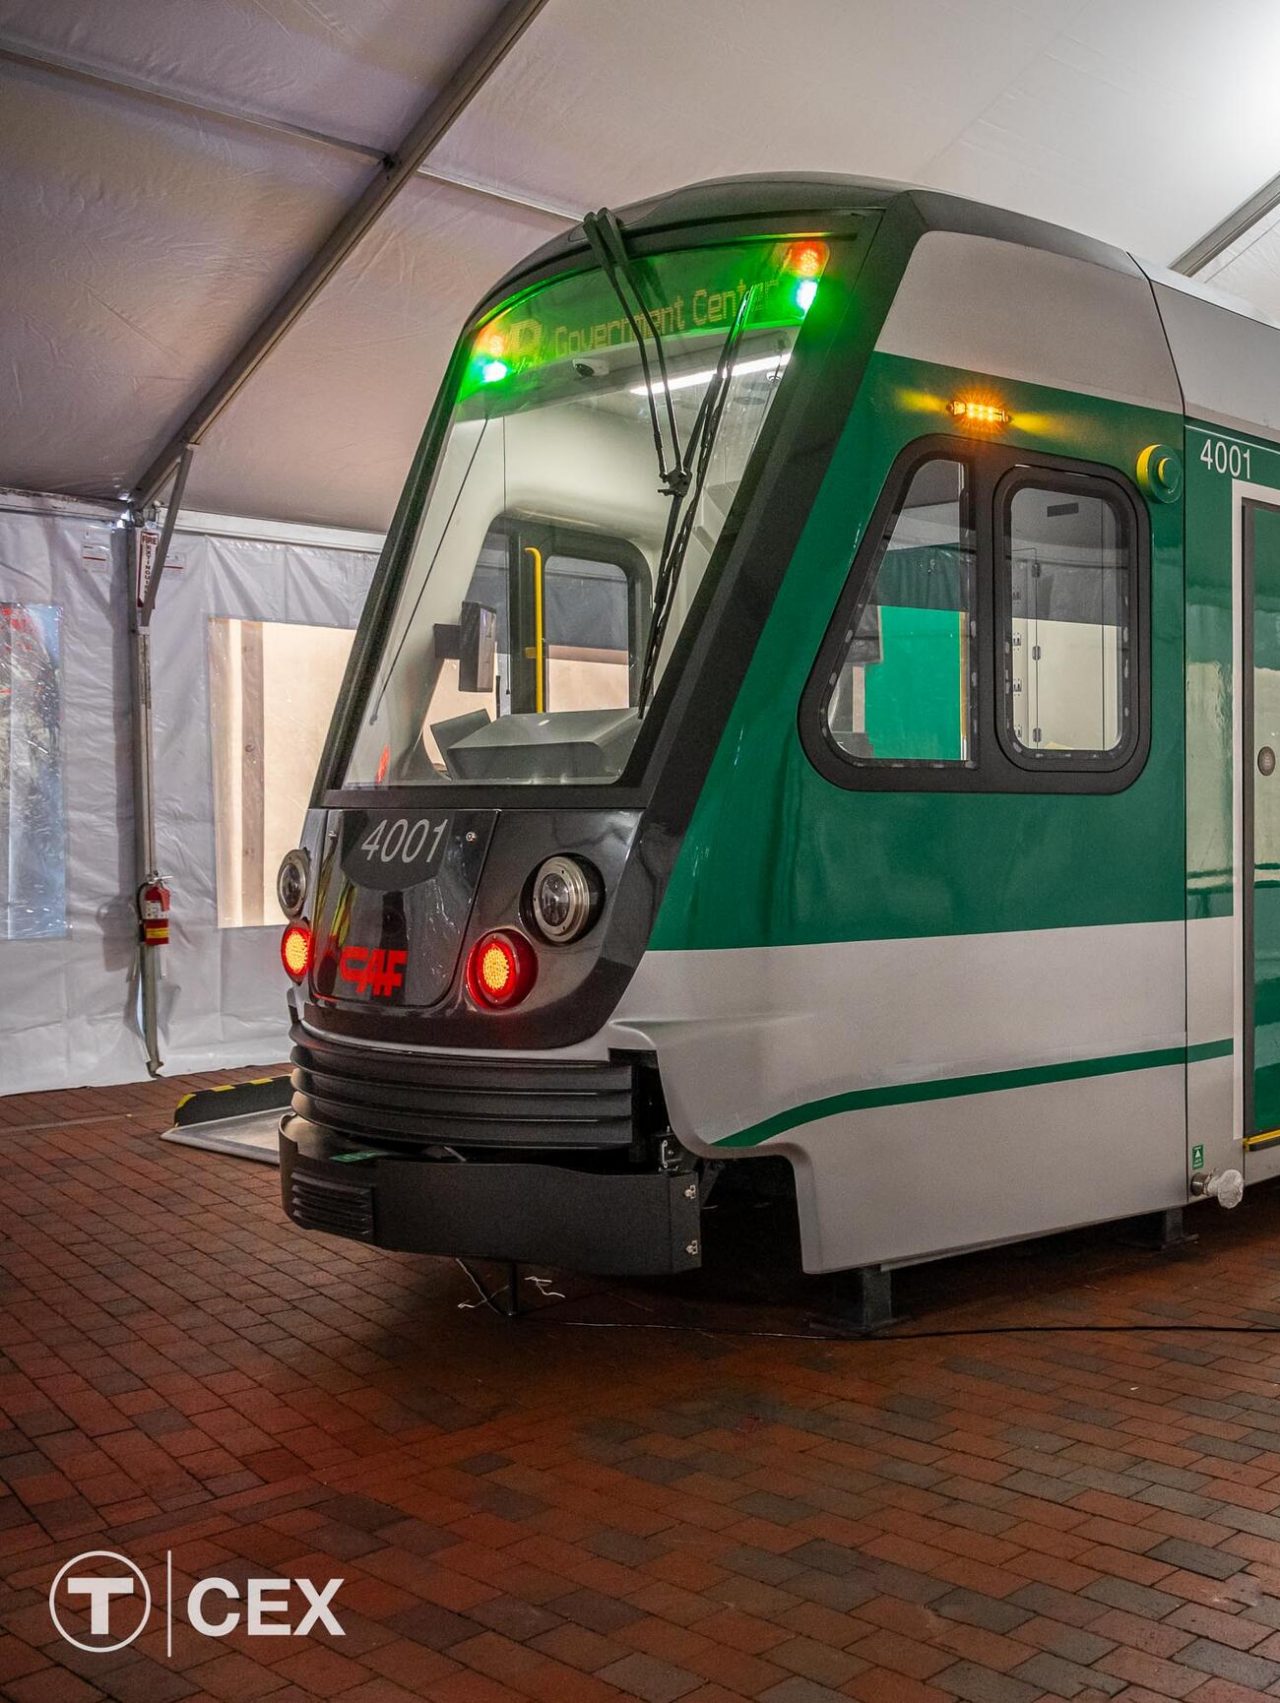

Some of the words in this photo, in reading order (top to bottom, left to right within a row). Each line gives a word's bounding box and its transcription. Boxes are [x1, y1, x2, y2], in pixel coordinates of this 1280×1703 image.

[555, 295, 685, 356] Government
[1200, 438, 1251, 479] 4001
[361, 818, 449, 864] 4001
[339, 945, 409, 997] CAF
